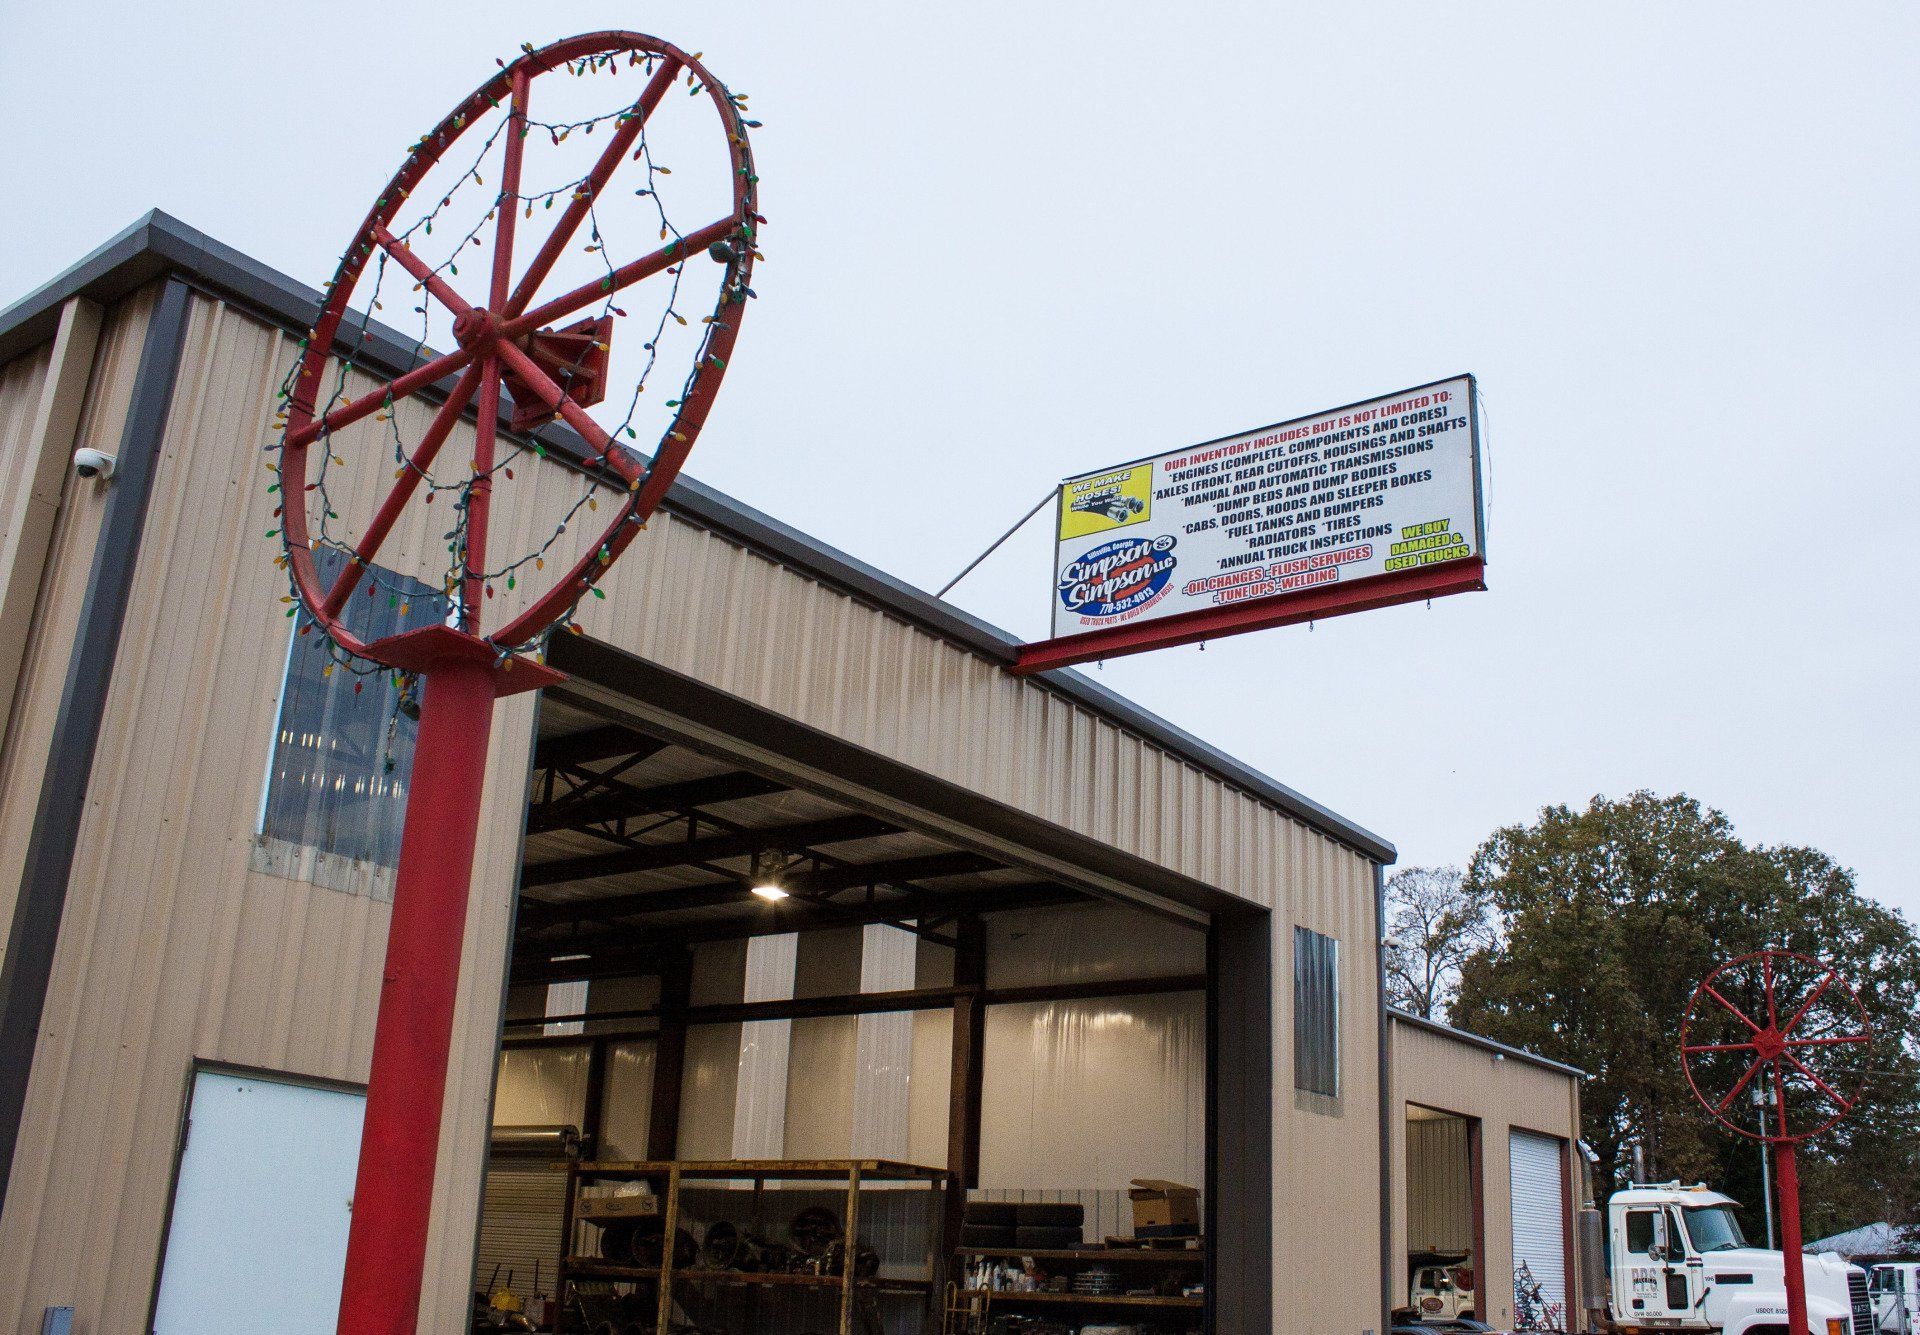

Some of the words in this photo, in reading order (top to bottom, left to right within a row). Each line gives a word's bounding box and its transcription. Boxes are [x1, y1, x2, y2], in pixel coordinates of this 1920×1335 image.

[1164, 458, 1187, 472] OUR
[1190, 441, 1251, 465] INVENTORY
[1254, 425, 1310, 449] INCLUDES
[1312, 420, 1335, 434] BUT
[1338, 416, 1350, 428] IS
[1354, 409, 1378, 424] NOT
[1380, 395, 1430, 417] LIMITED
[1432, 390, 1453, 404] TO:
[1235, 465, 1264, 481] REAR
[1323, 436, 1387, 460] HOUSINGS
[1389, 429, 1415, 444] AND
[1418, 416, 1467, 437] SHAFTS
[1289, 425, 1370, 453] COMPONENTS
[1373, 418, 1398, 434] AND
[1072, 482, 1091, 494] WE
[1094, 471, 1131, 488] MAKE
[1233, 480, 1256, 496] AND
[1259, 464, 1327, 489] AUTOMATIC
[1330, 439, 1434, 472] TRANSMISSIONS
[1252, 489, 1283, 505] BEDS
[1285, 481, 1310, 497] AND
[1312, 473, 1349, 491] DUMP
[1351, 462, 1398, 482] BODIES
[1076, 485, 1122, 503] HOSES!
[1221, 508, 1263, 526] DOORS,
[1266, 498, 1307, 516] HOODS
[1309, 491, 1335, 506] AND
[1337, 479, 1388, 500] SLEEPER
[1390, 469, 1432, 488] BOXES
[1256, 515, 1294, 532] TANKS
[1296, 508, 1321, 524] AND
[1323, 495, 1384, 517] BUMPERS
[1402, 525, 1422, 539] WE
[1423, 518, 1450, 535] BUY
[1267, 541, 1308, 559] TRUCK
[1310, 523, 1392, 550] INSPECTIONS
[1385, 556, 1418, 571] USED
[1418, 545, 1470, 564] TRUCKS
[1391, 534, 1450, 556] DAMAGED
[1452, 532, 1463, 543] &
[1058, 541, 1153, 589] Simpson
[1208, 568, 1264, 590] CHANGES
[1311, 546, 1370, 568] SERVICES
[1065, 563, 1153, 611] Simpson
[1152, 556, 1173, 573] LLC
[1100, 587, 1155, 615] 770-532-4013
[1251, 581, 1275, 596] UPS
